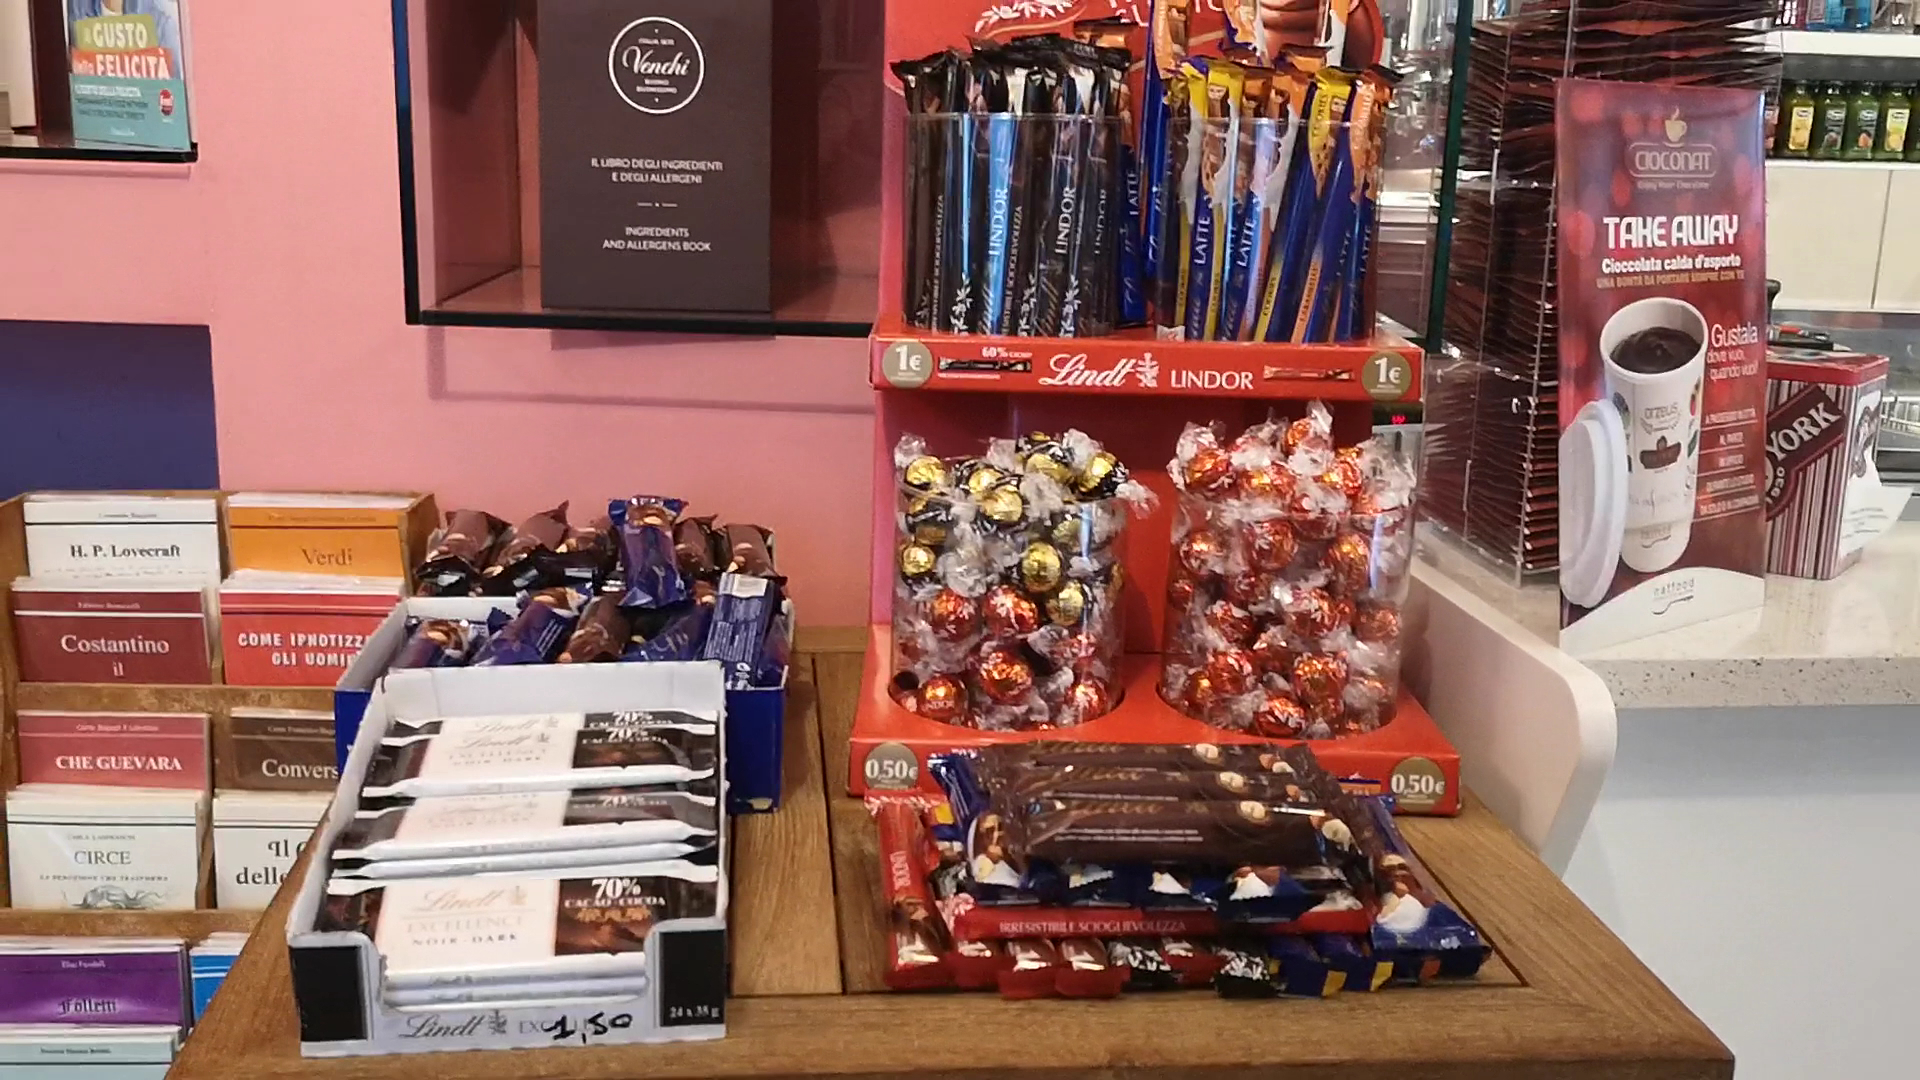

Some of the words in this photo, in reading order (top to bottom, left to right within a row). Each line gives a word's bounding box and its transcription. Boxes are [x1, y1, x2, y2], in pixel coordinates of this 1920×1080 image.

[92, 22, 149, 48] GUSTO
[95, 47, 171, 80] FELICITÀ
[621, 45, 691, 76] Venchi
[600, 158, 631, 169] LIBRO
[631, 158, 661, 170] DEGLI
[661, 159, 724, 172] INGREDIENTI
[1634, 150, 1713, 171] CIOCONAT
[611, 172, 618, 182] E
[620, 172, 649, 183] DEGLI
[650, 174, 703, 184] ALLERGENI
[624, 226, 690, 238] INGREDIENTS
[987, 187, 1010, 257] LINDOR
[1054, 186, 1077, 255] LINDOR
[1602, 215, 1668, 250] TAKE
[1670, 213, 1740, 248] AWAY
[602, 239, 626, 250] AND
[626, 240, 682, 251] ALLERGENS
[682, 241, 712, 252] BOOK
[1193, 215, 1211, 265] LATTE
[1235, 217, 1257, 268] LATTE
[1601, 256, 1663, 275] Cioccolata
[1663, 254, 1695, 272] calda
[1694, 252, 1742, 271] d'asporto
[1711, 321, 1759, 348] Gustala
[895, 344, 922, 372] 1€
[1038, 353, 1136, 387] Lindt
[1170, 369, 1254, 390] LINDOR
[1374, 356, 1402, 384] 1€
[1766, 401, 1842, 462] YORK
[70, 544, 89, 558] H.
[93, 544, 108, 558] P.
[111, 544, 181, 558] Lovecraft
[301, 547, 353, 567] Verdi
[60, 634, 170, 655] Costantino
[237, 632, 282, 648] COME
[112, 661, 124, 677] il
[271, 652, 297, 667] GLI
[55, 754, 94, 770] CHE
[96, 754, 183, 771] GUEVARA
[864, 758, 918, 781] 0,50€
[1390, 773, 1446, 796] 0,50€
[73, 850, 132, 866] CIRCE
[411, 888, 507, 912] Lindt
[592, 877, 642, 901] 70%
[563, 898, 612, 909] CACAO
[398, 1012, 486, 1039] Lindt
